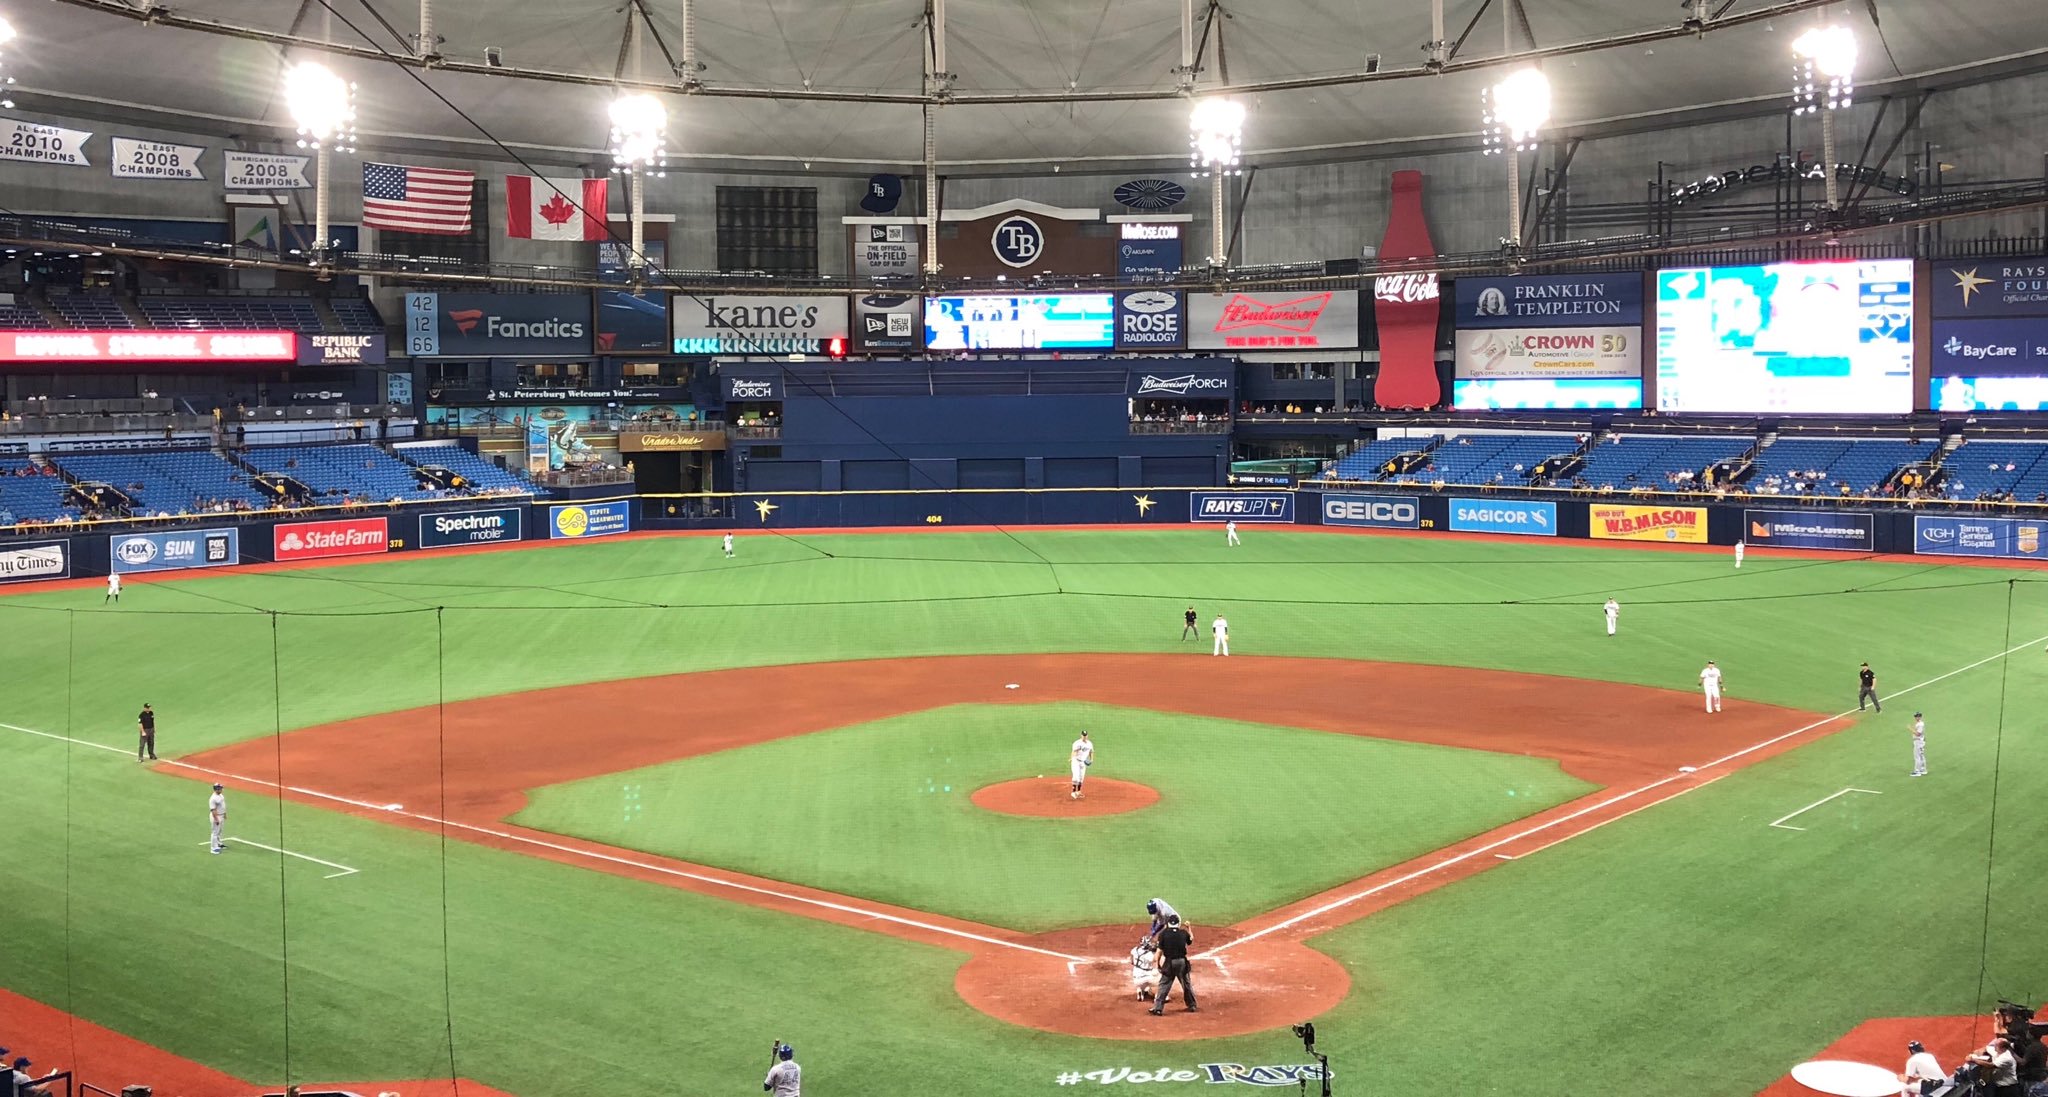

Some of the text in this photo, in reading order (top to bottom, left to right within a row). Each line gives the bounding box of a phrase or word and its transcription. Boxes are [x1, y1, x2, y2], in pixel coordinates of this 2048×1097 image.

[16, 124, 29, 132] AL
[11, 132, 63, 151] 2010
[137, 143, 176, 153] AL EAST
[0, 146, 76, 163] CHAMPIONS
[133, 151, 180, 167] 2008
[119, 164, 192, 178] CHAMPIONS
[244, 163, 288, 178] 2008
[231, 176, 300, 187] CHAMPIONS
[1001, 226, 1037, 258] TB
[866, 251, 907, 261] ON-FIELD
[2003, 266, 2046, 277] RAYS
[1515, 284, 1605, 299] FRANKLIN
[2004, 281, 2048, 291] FOU
[412, 297, 432, 311] 42
[2003, 294, 2029, 303] Official
[705, 298, 818, 328] kane's
[1224, 304, 1320, 322] Budweiser
[1515, 301, 1621, 316] TEMPLETON
[414, 317, 430, 331] 12
[487, 317, 583, 339] Fanatics
[1123, 314, 1178, 332] ROSE
[312, 335, 372, 347] REPUBLIC
[1123, 333, 1177, 342] RADIOLOGY
[1523, 333, 1627, 353] CROWN 50
[413, 337, 432, 352] 66
[324, 347, 360, 358] BANK
[1963, 345, 2017, 360] BayCare
[1143, 379, 1190, 388] Budweiser
[1189, 379, 1228, 388] PORCH
[499, 390, 512, 398] St.
[514, 391, 565, 399] Petersburg
[732, 387, 772, 397] PORCH
[1325, 501, 1416, 522] GEICO
[1457, 508, 1528, 523] SAGICOR
[436, 514, 501, 532] Spectrum
[926, 515, 942, 523] 404
[1420, 519, 1434, 528] 378
[470, 529, 501, 540] mobile
[1774, 524, 1865, 535] MicroLumen
[1928, 528, 1955, 539] TGH
[1959, 524, 1989, 534] Tampa
[1959, 532, 1994, 540] General
[126, 543, 148, 554] FOX
[164, 541, 195, 556] SUN
[208, 540, 225, 548] FOX
[389, 539, 403, 548] 378
[1959, 539, 1996, 548] Hospital
[209, 550, 225, 559] GO
[16, 556, 57, 570] Times
[1055, 1067, 1200, 1085] #Vote
